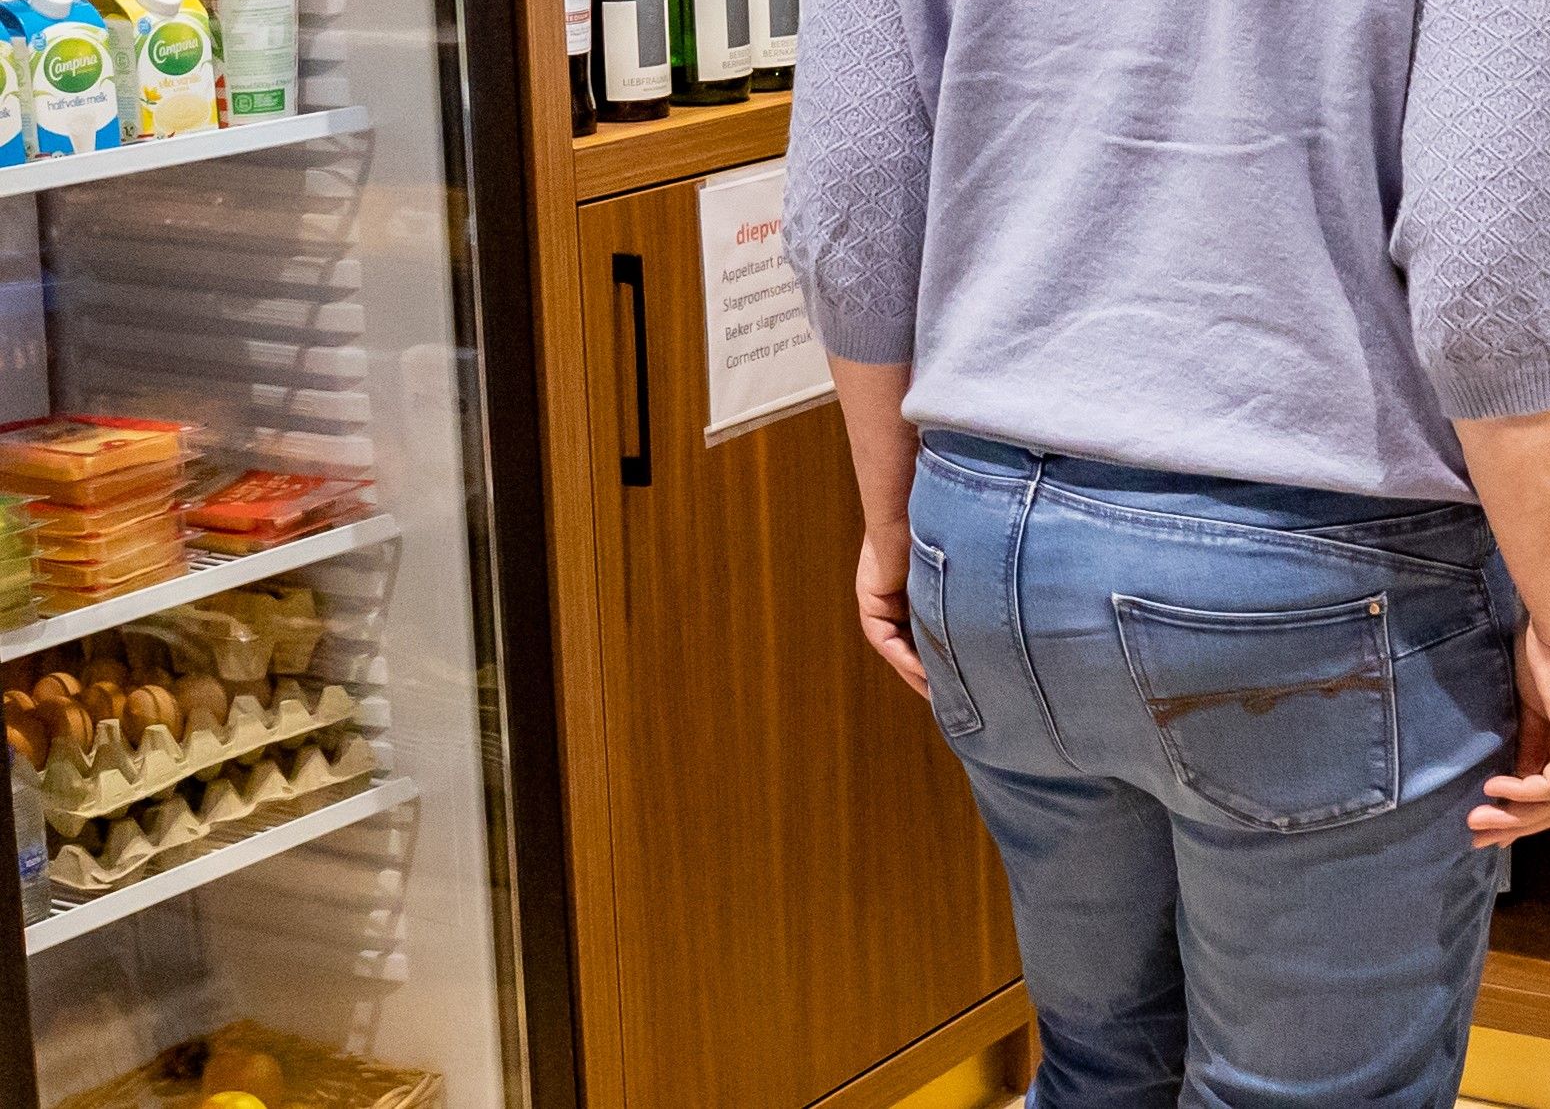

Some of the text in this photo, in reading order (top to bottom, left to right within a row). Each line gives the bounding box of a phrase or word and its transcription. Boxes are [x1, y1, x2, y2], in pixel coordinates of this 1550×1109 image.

[153, 38, 198, 64] Campina
[49, 53, 98, 81] Campina
[721, 257, 774, 284] Appeltaart
[722, 276, 800, 313] Slagroomsoesje
[725, 321, 754, 341] Beker
[725, 329, 813, 370] Cornetto per stuk
